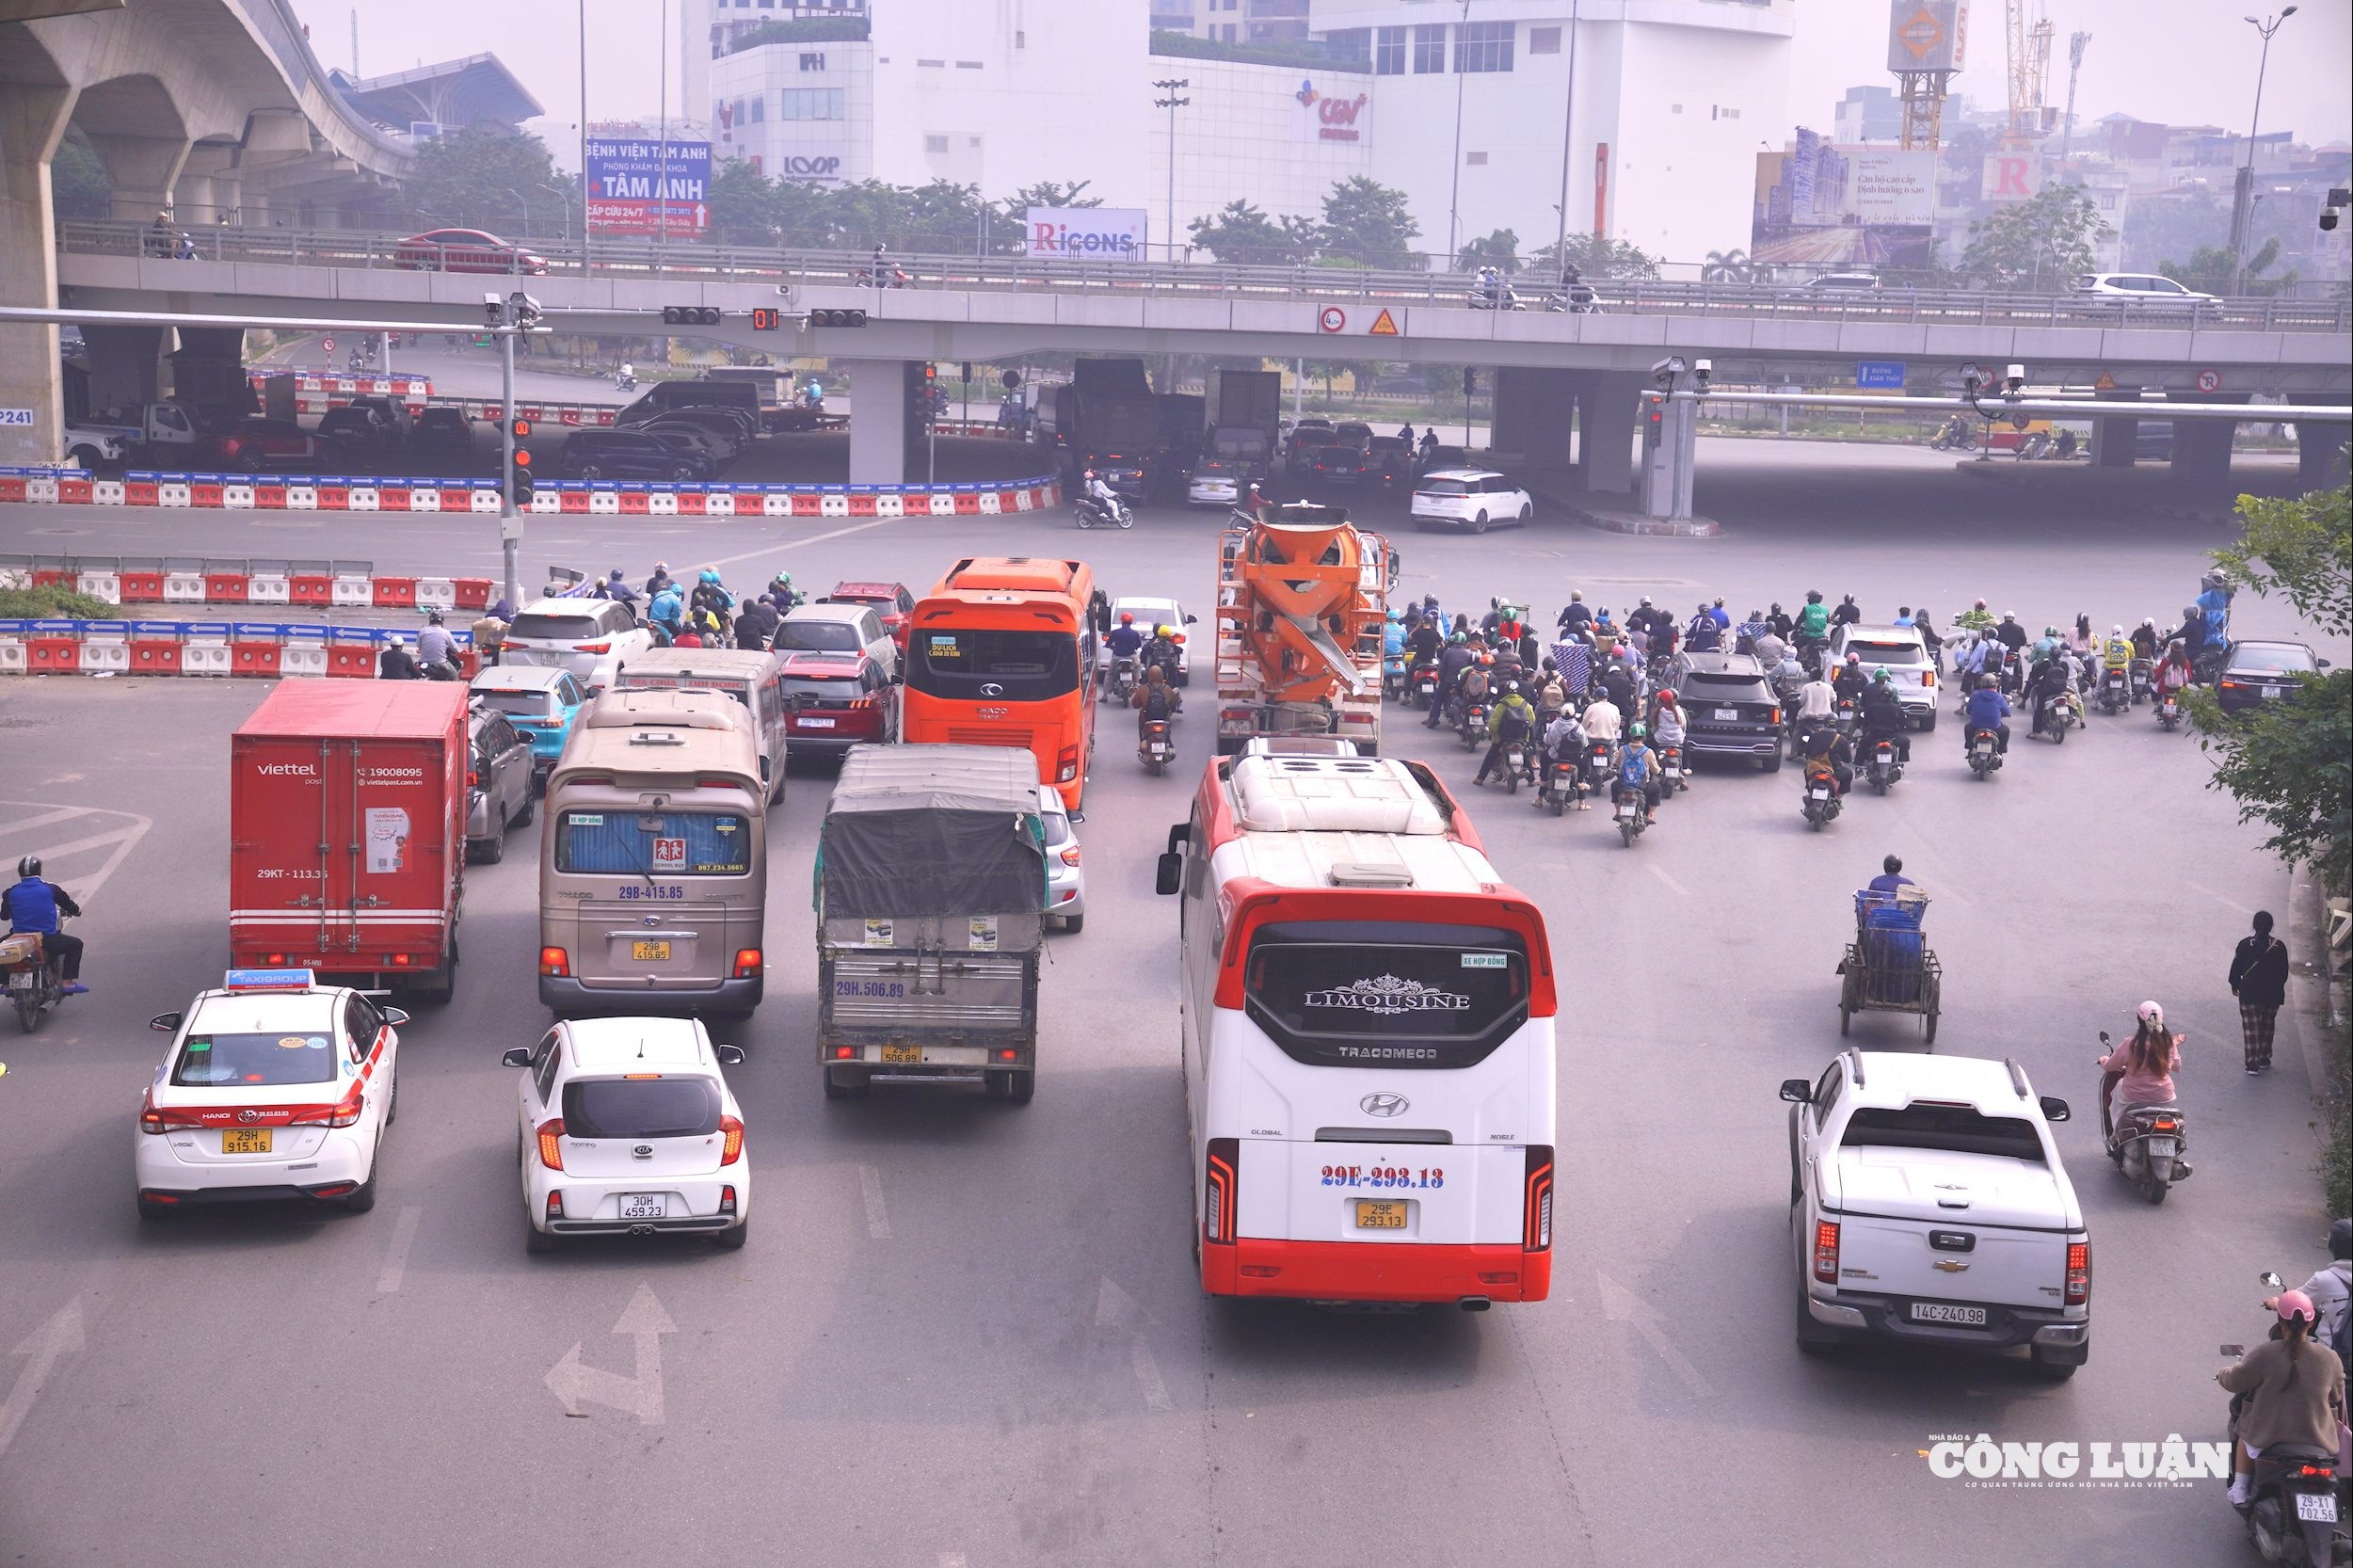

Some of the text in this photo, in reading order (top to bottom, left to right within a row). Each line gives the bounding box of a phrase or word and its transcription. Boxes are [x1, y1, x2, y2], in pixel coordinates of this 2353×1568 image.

[1319, 93, 1367, 124] CGV
[619, 143, 648, 161] VIỆN
[680, 148, 707, 160] ANH
[666, 165, 688, 173] KHOA
[784, 156, 840, 174] LOOP
[1995, 157, 2030, 195] R
[603, 172, 703, 200] TÂM ANH
[623, 207, 644, 218] 24/7
[754, 309, 777, 329] 01
[2110, 642, 2126, 653] be
[257, 763, 316, 776] viettel
[370, 768, 423, 776] 19008095
[257, 869, 284, 879] 29KT
[619, 886, 683, 900] 29B-415.85
[644, 942, 660, 951] 29B
[637, 951, 666, 959] 415.85
[1473, 957, 1486, 967] HỢP
[1487, 956, 1505, 966] ĐỒNG
[837, 981, 904, 998] 29H.506.89
[1305, 993, 1470, 1010] LIMOUSINE
[886, 1053, 917, 1063] 506.89
[1339, 1047, 1437, 1060] TRACOMECO
[237, 1130, 258, 1140] 29H
[228, 1142, 266, 1153] 915.16
[637, 1145, 651, 1154] KIA
[1321, 1165, 1444, 1189] 29E-293.13
[633, 1196, 654, 1206] 30H
[625, 1207, 662, 1217] 459.23
[1371, 1205, 1393, 1215] 29E
[1363, 1216, 1401, 1226] 293.13
[1915, 1304, 1984, 1322] 14C-240.98
[2301, 1496, 2329, 1508] 29-X1
[2300, 1507, 2334, 1521] 702.56
